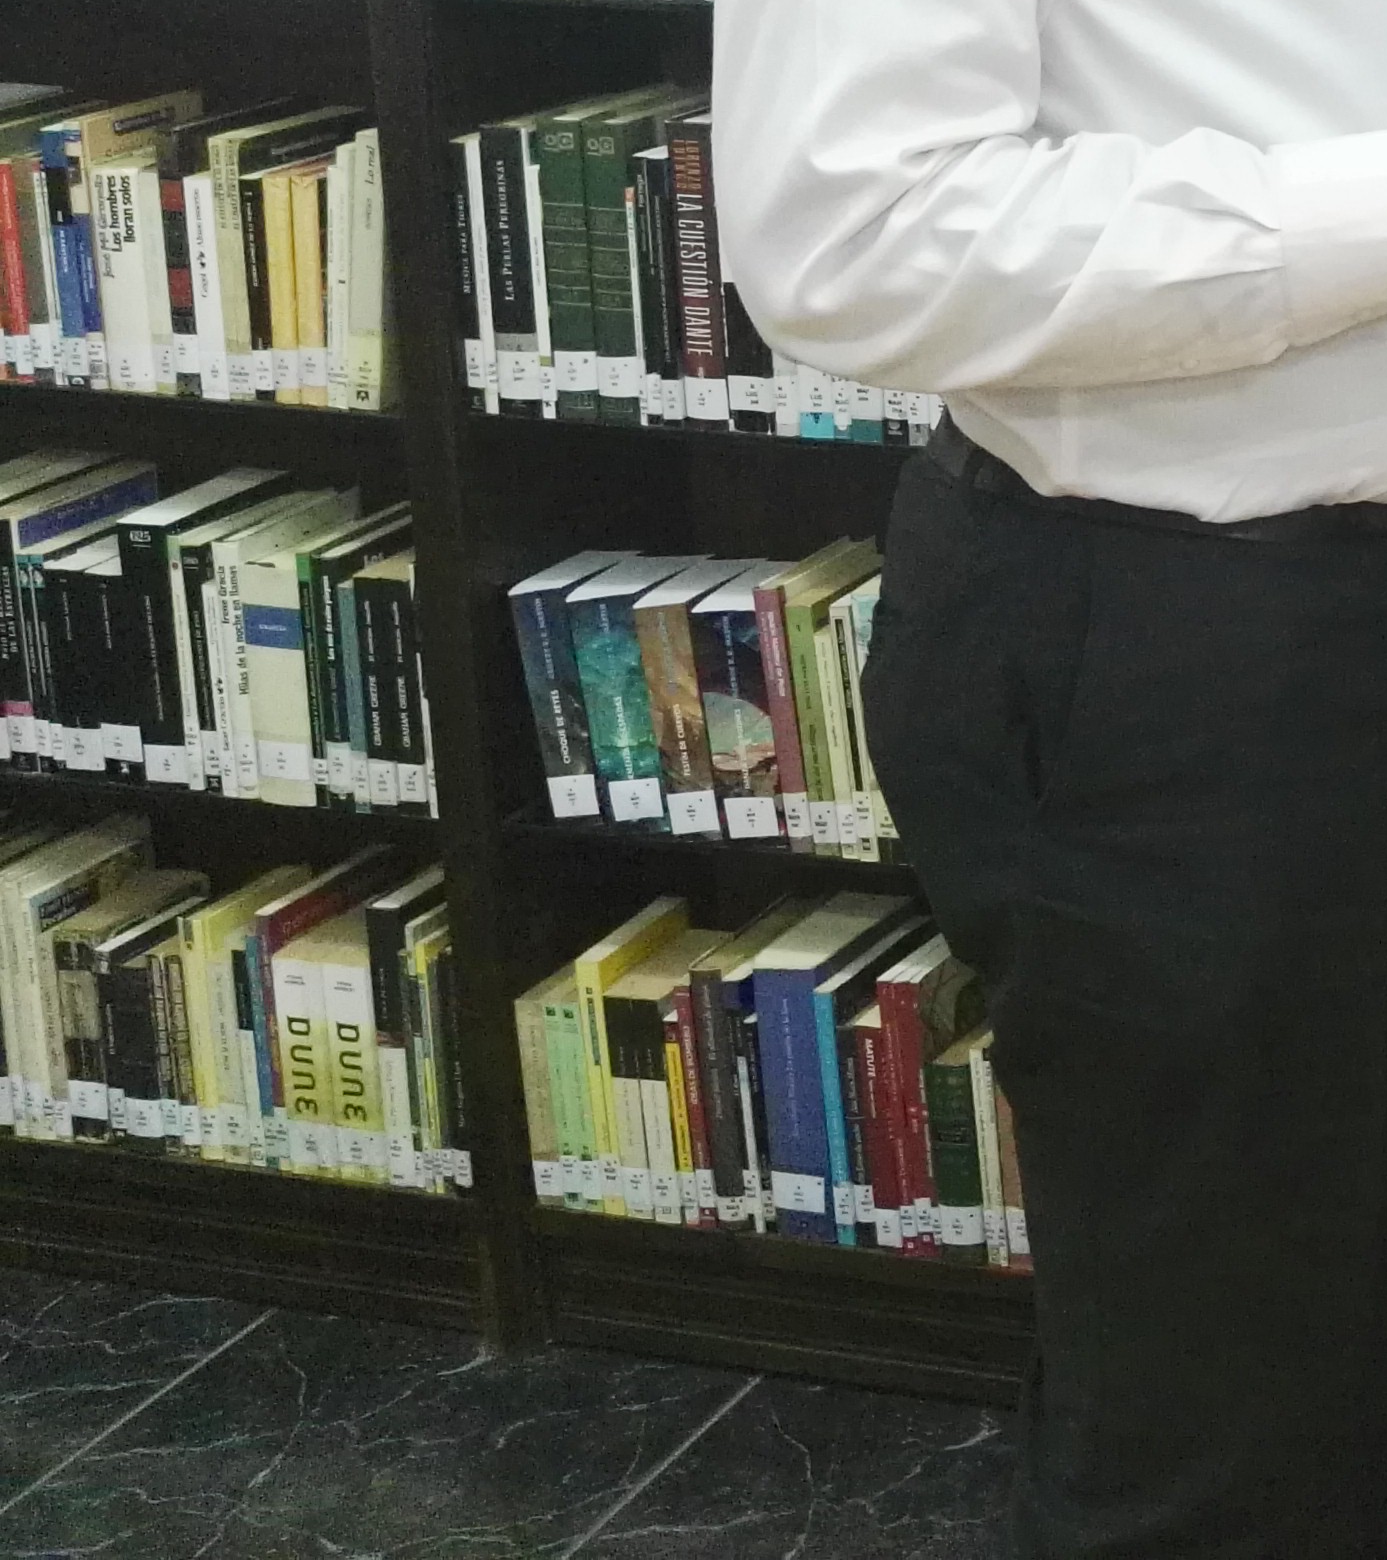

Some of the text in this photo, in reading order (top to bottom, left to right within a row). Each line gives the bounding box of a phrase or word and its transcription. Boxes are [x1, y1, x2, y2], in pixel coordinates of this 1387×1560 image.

[105, 175, 123, 252] Los hombres
[118, 175, 137, 243] lloran solos
[675, 192, 718, 357] LA CUESTIÓN DANTE
[286, 1015, 319, 1116] DUNE
[335, 1021, 368, 1123] DUNE
